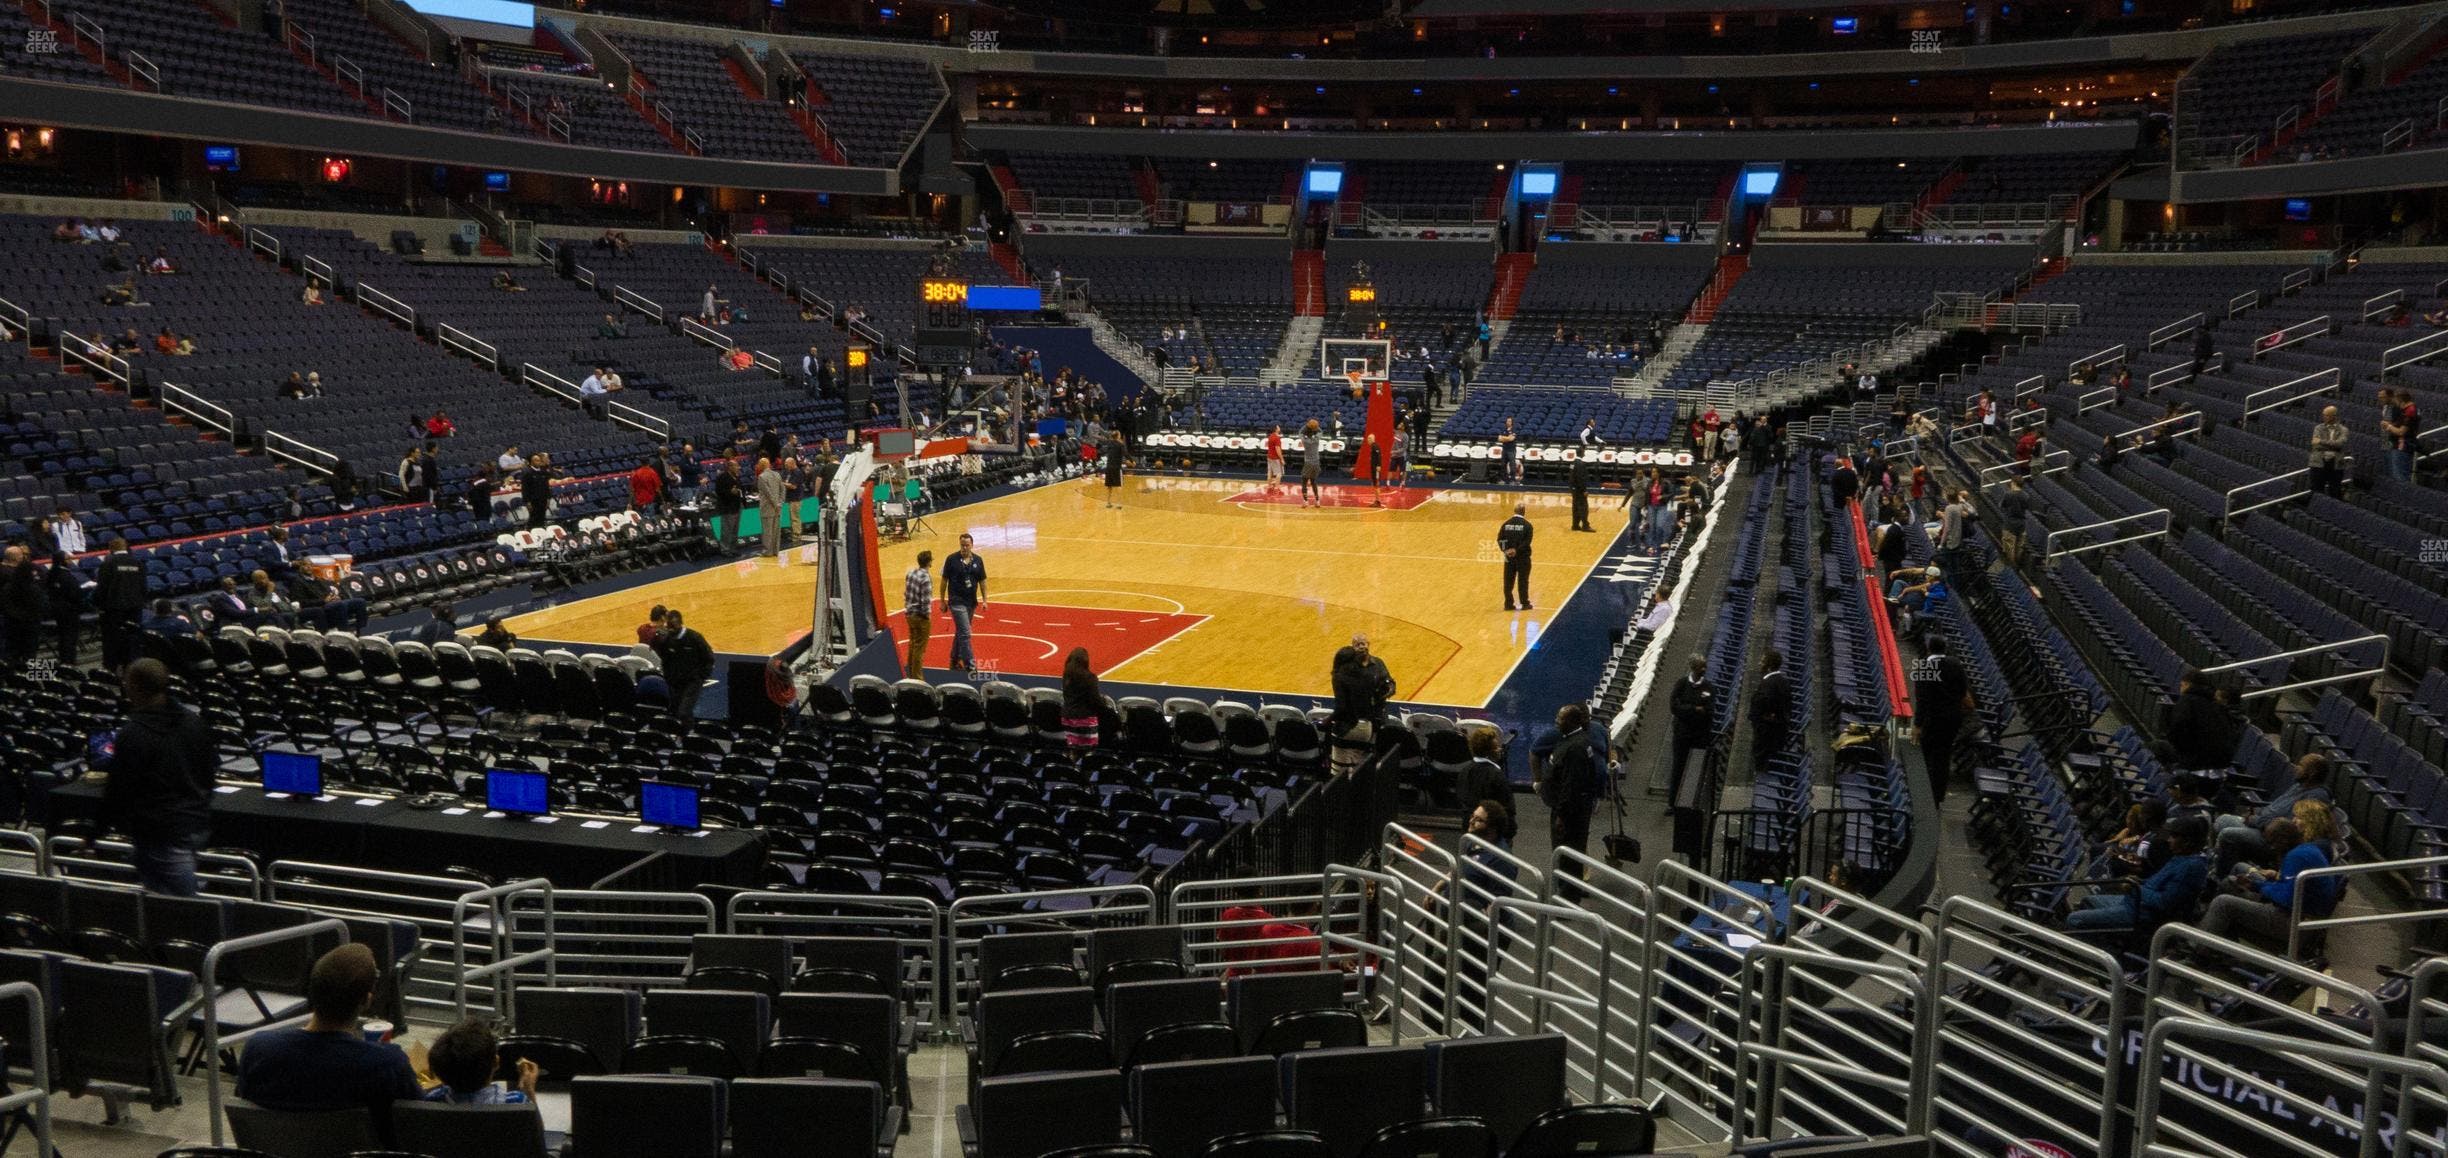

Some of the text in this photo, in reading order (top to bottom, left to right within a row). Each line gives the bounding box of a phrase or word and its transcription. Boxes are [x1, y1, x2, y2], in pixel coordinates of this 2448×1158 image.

[924, 283, 967, 301] 38:04
[1349, 290, 1375, 301] 38:04
[2091, 1024, 2296, 1120] OFICIAL
